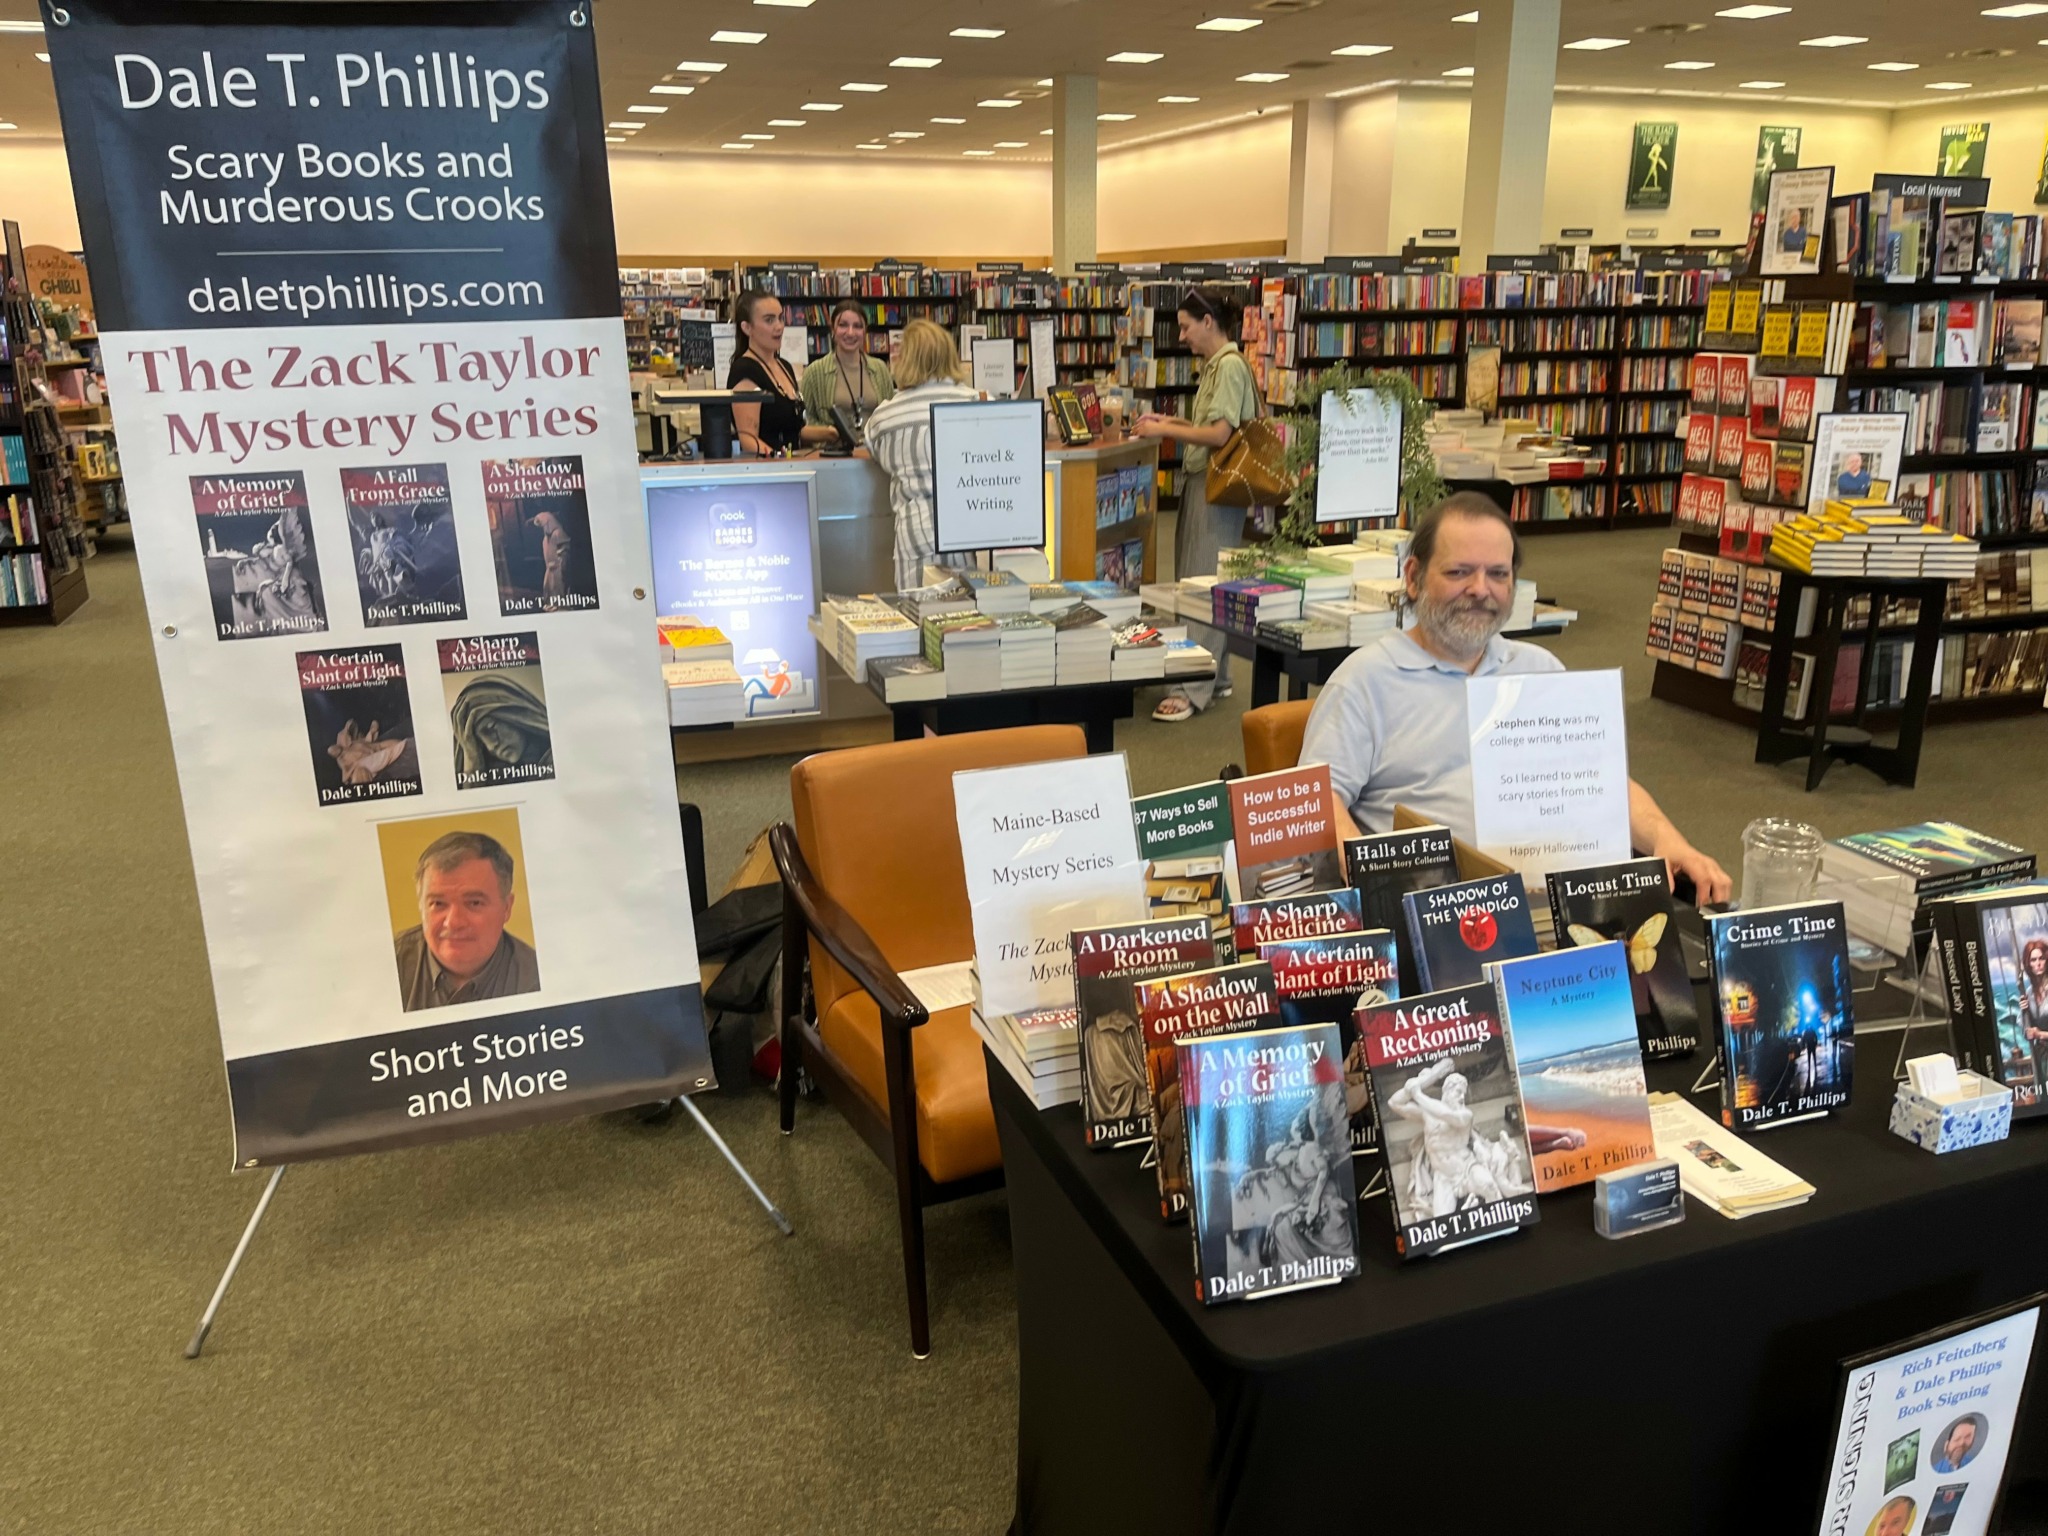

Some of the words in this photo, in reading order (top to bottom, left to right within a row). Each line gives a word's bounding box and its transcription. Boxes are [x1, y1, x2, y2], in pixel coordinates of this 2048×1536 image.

[114, 51, 256, 110] Dale
[266, 53, 320, 108] T.
[338, 52, 549, 123] Phillips
[1943, 124, 1982, 136] INVISIBLE
[1966, 132, 1985, 142] MAN
[168, 145, 284, 187] Scary
[298, 143, 424, 179] Books
[437, 143, 513, 179] and
[1902, 182, 1926, 196] Local
[1928, 183, 1962, 198] Interest
[161, 189, 393, 225] Murderous
[406, 186, 544, 222] Crooks
[1353, 260, 1373, 270] Fiction
[1513, 258, 1532, 268] Fiction
[1665, 257, 1683, 267] Fiction
[40, 278, 81, 296] GHIBLI
[188, 274, 543, 317] daletphillips.com
[128, 346, 252, 393] The
[267, 340, 414, 389] Zack
[420, 336, 600, 391] Taylor
[1786, 390, 1811, 411] HELL
[164, 410, 417, 463] Mystery
[431, 397, 598, 442] Series
[1782, 411, 1809, 429] TOWN
[961, 450, 1001, 464] Travel
[1004, 449, 1015, 462] &
[1746, 453, 1769, 473] HELL
[388, 468, 418, 484] Fall
[504, 460, 572, 477] Shadow
[218, 478, 295, 494] Memory
[514, 478, 542, 492] the
[545, 474, 584, 490] Wall
[956, 475, 1021, 488] Adventure
[1744, 473, 1769, 490] TOWN
[241, 492, 286, 509] Grief
[350, 487, 395, 503] From
[398, 485, 445, 499] Grace
[966, 497, 1014, 511] Writing
[720, 510, 745, 522] nook
[679, 559, 702, 571] The
[758, 555, 790, 567] Noble
[367, 605, 397, 620] Dale
[412, 601, 461, 616] Phillips
[505, 598, 534, 611] Dale
[550, 593, 596, 608] Phillips
[221, 622, 254, 636] Dale
[272, 615, 325, 631] Phillips
[470, 636, 519, 651] Sharp
[329, 650, 384, 667] Certain
[451, 647, 527, 666] Medicine
[302, 670, 343, 686] Slant
[363, 663, 402, 680] Light
[1494, 718, 1536, 731] Stephen
[1538, 716, 1560, 728] King
[1489, 735, 1525, 747] college
[1527, 733, 1562, 745] writing
[1564, 730, 1605, 742] teacher!
[457, 770, 488, 784] Dale
[503, 763, 553, 779] Phillips
[1521, 771, 1558, 783] learned
[1574, 769, 1600, 779] write
[321, 786, 352, 801] Dale
[368, 779, 418, 796] Phillips
[1243, 790, 1274, 807] How
[1277, 785, 1291, 799] to
[1294, 781, 1310, 796] be
[1498, 791, 1524, 802] scary
[1526, 788, 1559, 800] stories
[1561, 785, 1584, 797] from
[1587, 784, 1604, 795] the
[992, 802, 1101, 834] Maine-Based
[1149, 806, 1182, 822] Ways
[1197, 796, 1218, 812] Sell
[1248, 798, 1321, 826] Successful
[1539, 805, 1564, 816] best!
[1146, 827, 1176, 844] More
[1178, 819, 1214, 837] Books
[1250, 828, 1284, 846] Indie
[1286, 819, 1326, 839] Writer
[1356, 845, 1397, 861] Halls
[1402, 839, 1417, 855] of
[1421, 837, 1450, 853] Fear
[1509, 844, 1541, 858] Happy
[1543, 840, 1599, 854] Halloween!
[992, 863, 1060, 886] Mystery
[1065, 853, 1114, 874] Series
[1369, 861, 1390, 871] Short
[1393, 859, 1412, 869] Story
[1415, 854, 1450, 866] Collection
[1981, 865, 1996, 878] Rich
[1997, 859, 2032, 874] Feitelberg
[1565, 878, 1618, 897] Locust
[1621, 873, 1662, 889] Time
[1428, 885, 1489, 909] SHADOW
[1277, 901, 1338, 923] Sharp
[1422, 911, 1451, 926] THE
[1453, 896, 1519, 919] WENDIGO
[1100, 920, 1208, 947] Darkened
[1253, 916, 1347, 943] Medicine
[1726, 922, 1783, 943] Crime
[1788, 916, 1836, 935] Time
[999, 942, 1029, 961] The
[1034, 932, 1073, 956] Zack
[1304, 943, 1374, 965] Certain
[1113, 947, 1179, 969] Room
[1274, 969, 1319, 990] Slant
[1322, 966, 1343, 986] of
[1346, 961, 1397, 984] Light
[1521, 972, 1583, 995] Neptune
[1589, 965, 1617, 983] City
[1943, 939, 1957, 985] Blessed
[1951, 985, 1965, 1015] Lady
[1178, 976, 1258, 1006] Shadow
[1561, 991, 1595, 1005] Mystery
[1154, 1014, 1182, 1035] on
[1186, 1006, 1221, 1031] the
[1224, 992, 1270, 1021] Wall
[1412, 996, 1471, 1026] Great
[1380, 1017, 1492, 1058] Reckoning
[1647, 1035, 1696, 1053] Phillips
[369, 1040, 463, 1082] Short
[472, 1024, 585, 1064] Stories
[1223, 1040, 1325, 1071] Memory
[1451, 1041, 1482, 1058] Mystery
[1219, 1073, 1243, 1097] of
[1251, 1061, 1313, 1093] Grief
[406, 1076, 472, 1118] and
[481, 1067, 568, 1106] More
[2014, 1085, 2043, 1101] RICH
[1742, 1107, 1774, 1123] Dale
[1797, 1091, 1847, 1110] Phillips
[1094, 1119, 1134, 1142] Dale
[1543, 1163, 1577, 1181] Dale
[1603, 1144, 1653, 1166] Phillips
[1408, 1220, 1448, 1247] Dale
[1468, 1199, 1533, 1229] Phillips
[1209, 1271, 1255, 1297] Dale
[1259, 1266, 1277, 1287] T.
[1281, 1255, 1355, 1281] Phillips
[1901, 1357, 1932, 1378] Rich
[1935, 1336, 2009, 1366] Feitelberg
[1913, 1375, 1945, 1395] Dale
[1949, 1359, 2003, 1384] Phillips
[1897, 1397, 1933, 1420] Book
[1936, 1382, 1991, 1410] Signing
[1835, 1371, 1876, 1504] SIGNING
